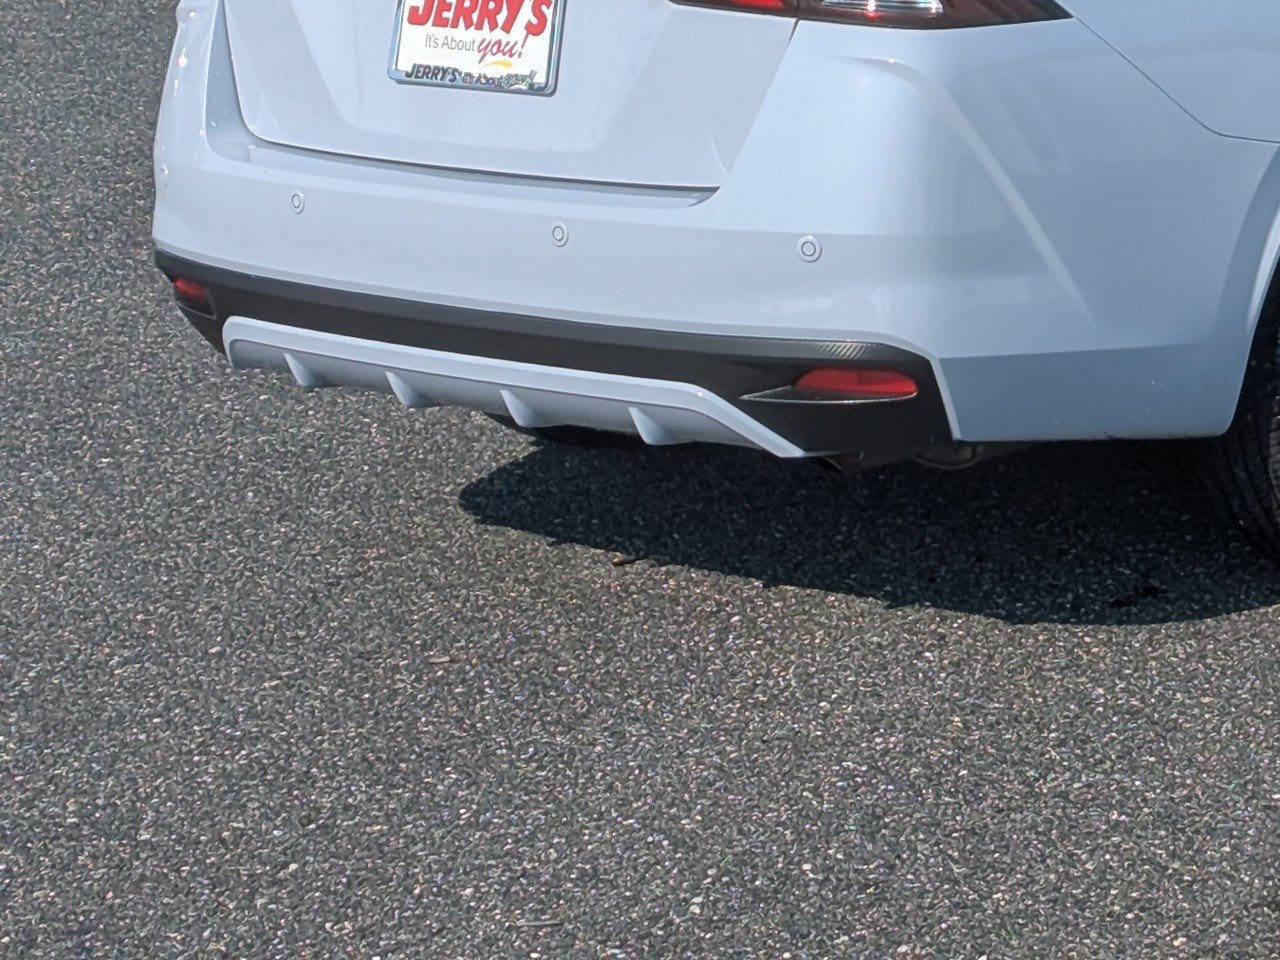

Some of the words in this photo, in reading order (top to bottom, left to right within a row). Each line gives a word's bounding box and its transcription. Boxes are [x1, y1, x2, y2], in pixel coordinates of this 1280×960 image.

[425, 33, 439, 49] It's
[440, 34, 475, 52] About
[476, 29, 529, 65] you!
